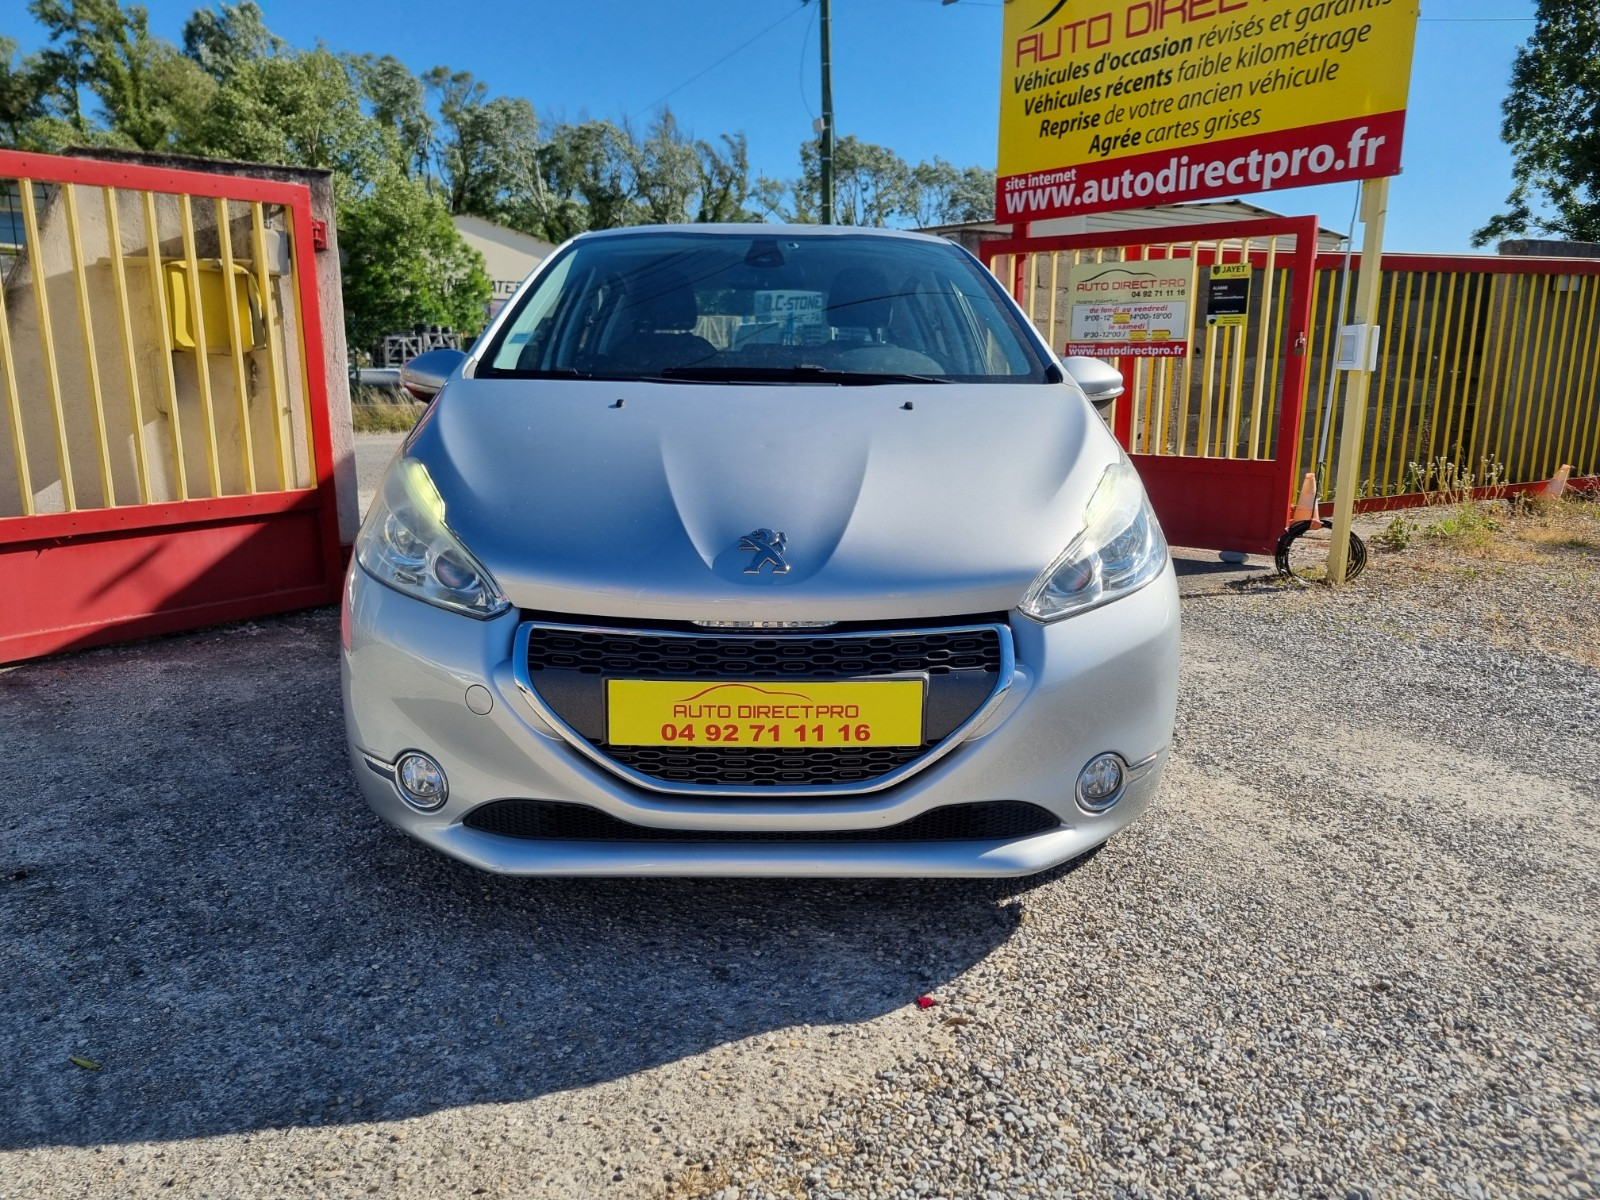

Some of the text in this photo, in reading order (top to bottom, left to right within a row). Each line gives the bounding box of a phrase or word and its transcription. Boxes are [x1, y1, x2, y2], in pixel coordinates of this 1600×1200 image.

[1016, 0, 1270, 68] AUTO DIRE
[1014, 0, 1392, 94] Véhicules d'occasion révisés et garan
[1024, 24, 1372, 116] Véhicules récents faible kilométrage
[1039, 58, 1340, 139] Reprise de votre ancien véhicule
[1088, 105, 1261, 157] Agrée cartes grises
[1005, 126, 1386, 214] www.autodirectpro.fr
[1005, 168, 1077, 191] site internet
[1222, 265, 1246, 273] JAYET
[1076, 278, 1186, 292] AUTO DIRECT PRO
[1089, 306, 1098, 314] du
[1100, 305, 1120, 313] lundi
[1133, 304, 1169, 312] vendredi
[1068, 345, 1184, 356] www.autodirectpro.fr
[673, 704, 731, 719] AUTO
[661, 723, 871, 742] 04 92 71 11 16
